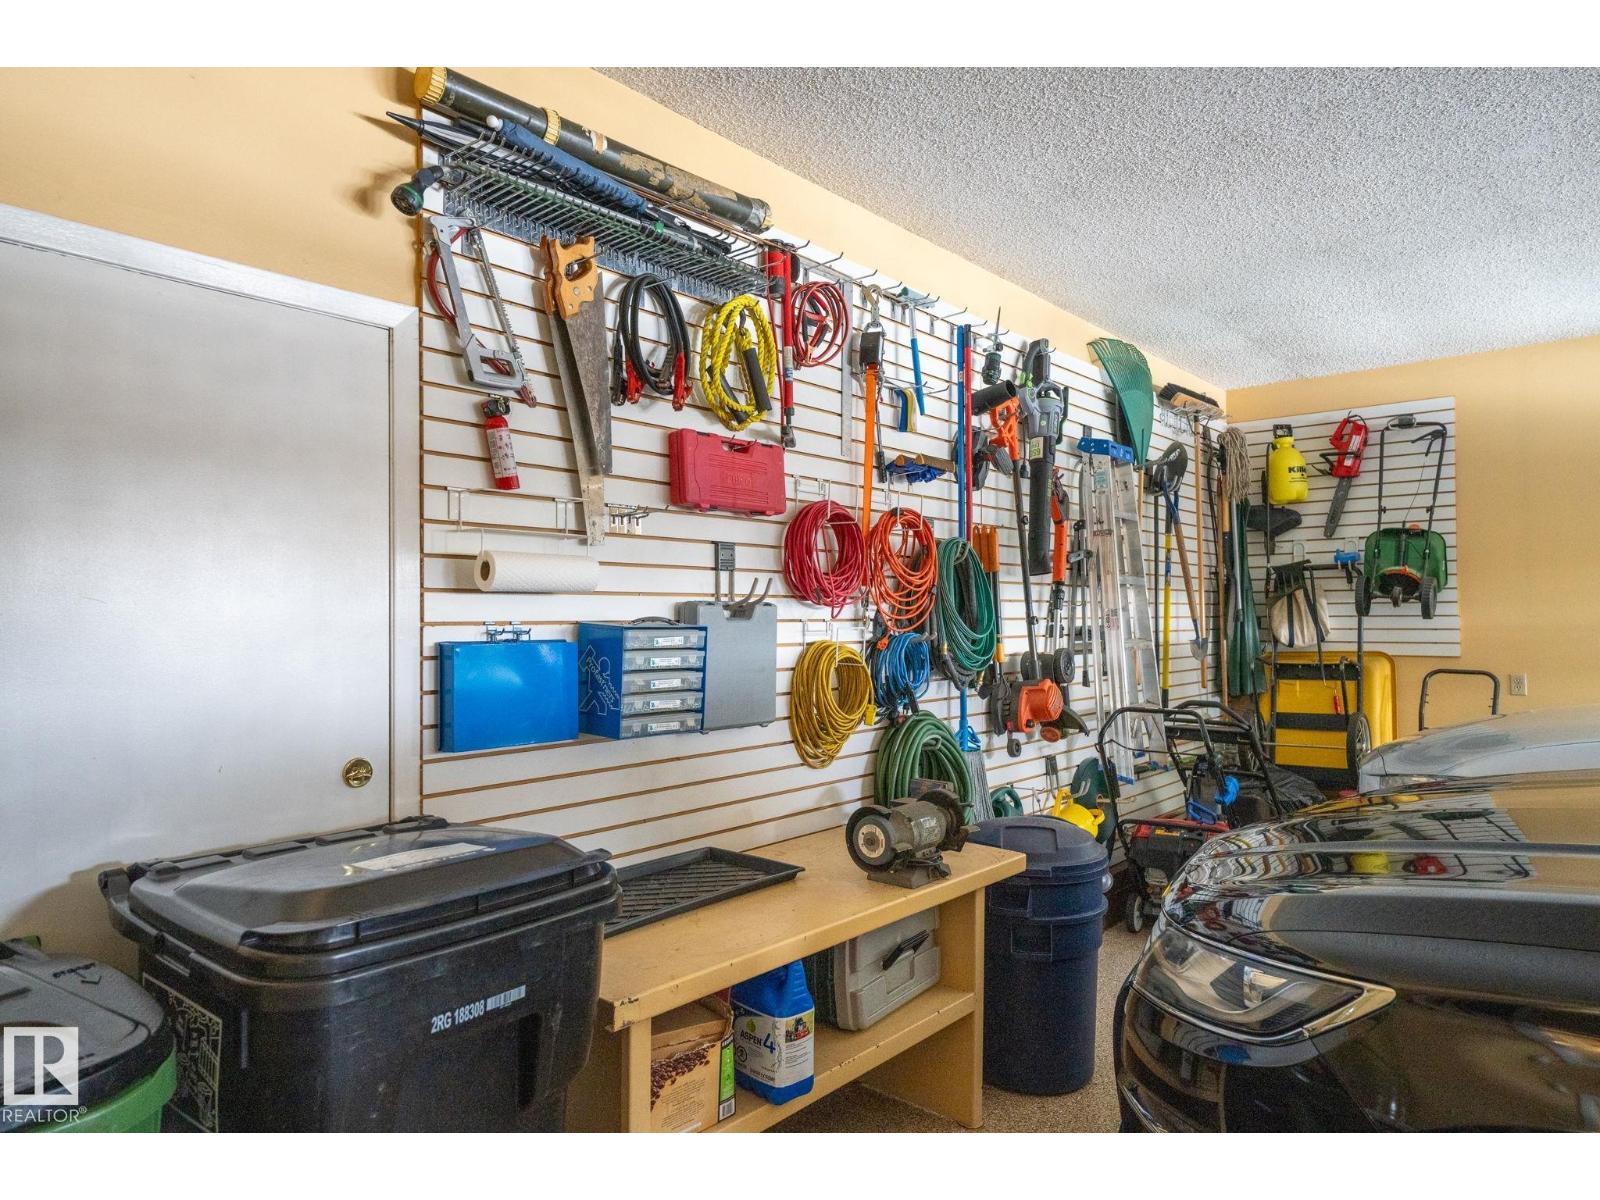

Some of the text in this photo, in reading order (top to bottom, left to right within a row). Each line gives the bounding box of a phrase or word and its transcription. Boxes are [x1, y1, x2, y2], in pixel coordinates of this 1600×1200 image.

[431, 1000, 485, 1035] 2RG 188308
[740, 1030, 762, 1046] ASPEN
[763, 1033, 776, 1054] 4
